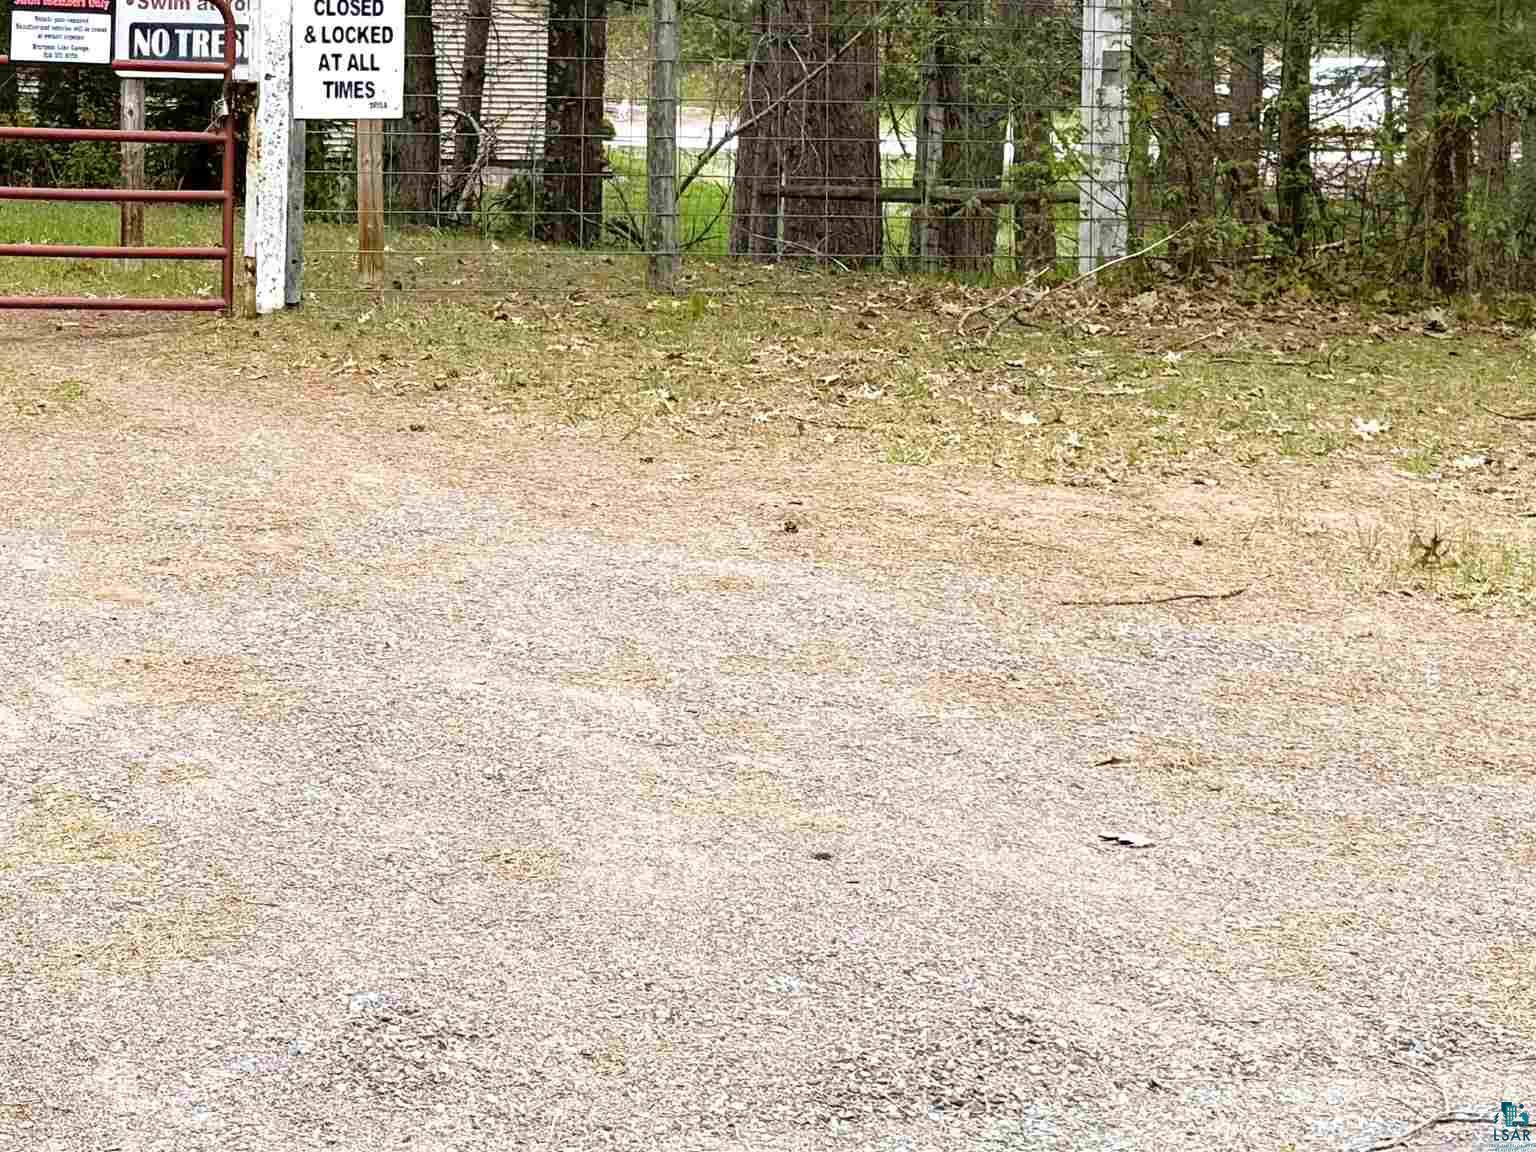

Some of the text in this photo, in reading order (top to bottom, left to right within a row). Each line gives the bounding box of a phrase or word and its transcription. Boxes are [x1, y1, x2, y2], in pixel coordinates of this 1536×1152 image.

[133, 29, 170, 57] NO
[304, 25, 394, 44] & LOCKED
[318, 53, 380, 71] AT ALL
[322, 81, 376, 99] TIMES
